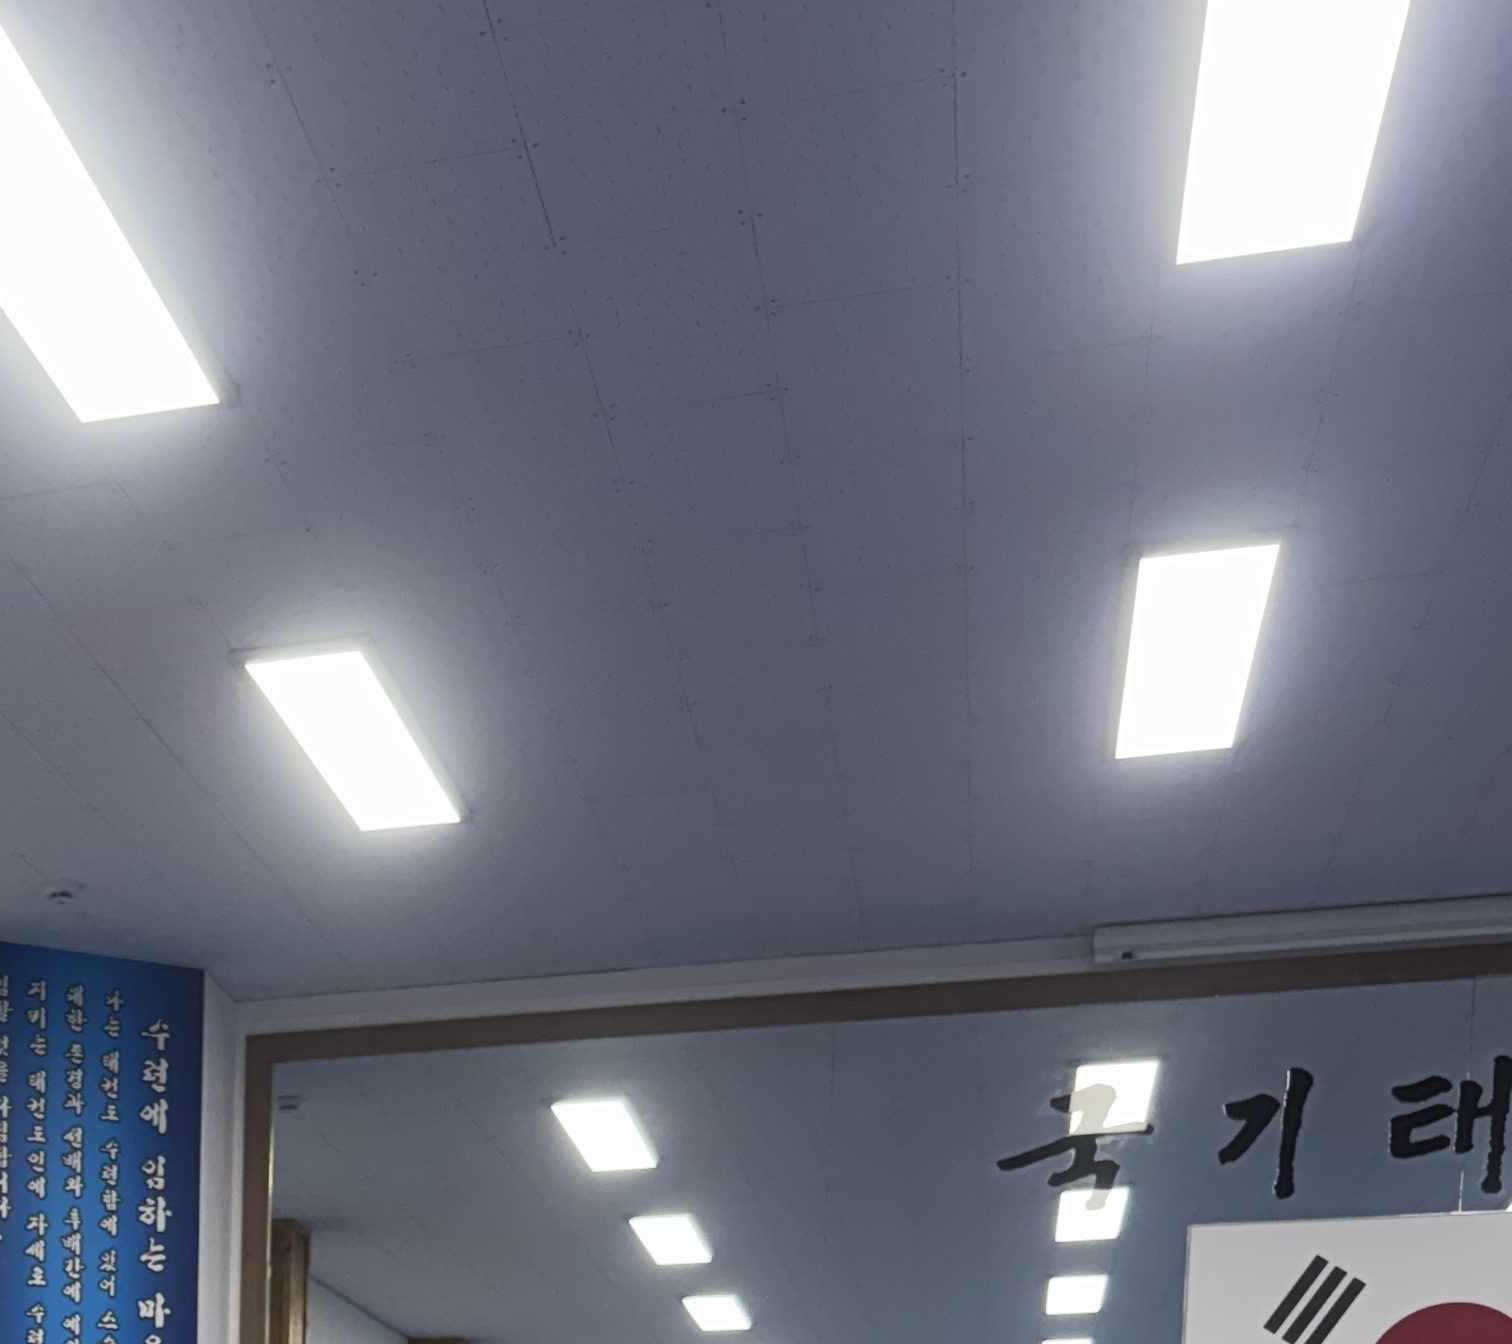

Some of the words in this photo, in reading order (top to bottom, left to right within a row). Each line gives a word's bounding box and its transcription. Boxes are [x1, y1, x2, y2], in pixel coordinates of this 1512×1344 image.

[27, 980, 47, 1056] 지키는
[66, 985, 87, 1032] 대한
[104, 990, 124, 1037] 나는
[64, 1044, 85, 1115] 존경과
[100, 1051, 119, 1121] 태권도
[139, 1018, 170, 1134] 수련에
[62, 1127, 84, 1198] 선배와
[99, 1140, 121, 1236] 수련함에
[25, 1213, 48, 1285] 자세로
[138, 1155, 172, 1272] 임하는
[61, 1207, 85, 1303] 후배간에
[99, 1250, 116, 1296] 있어
